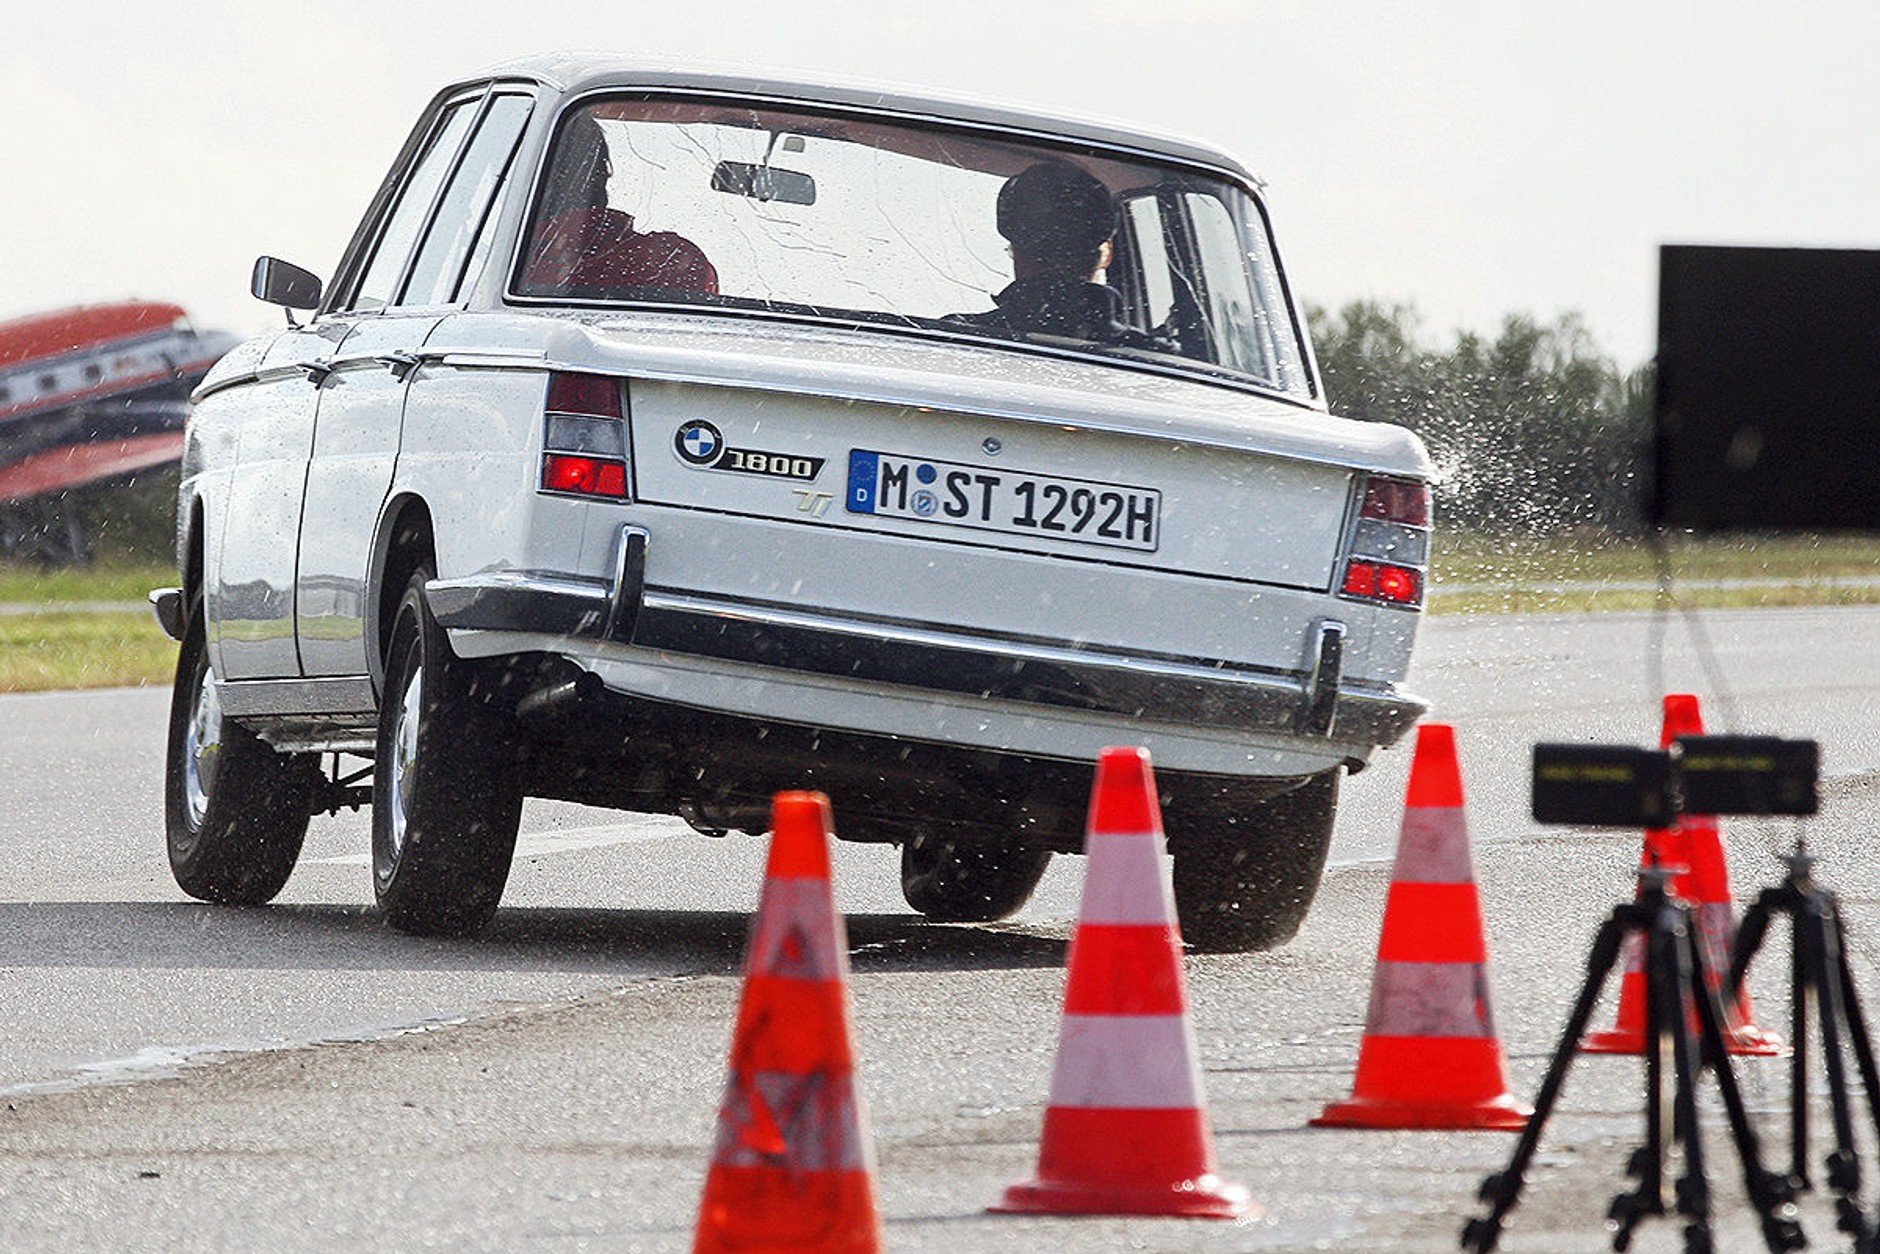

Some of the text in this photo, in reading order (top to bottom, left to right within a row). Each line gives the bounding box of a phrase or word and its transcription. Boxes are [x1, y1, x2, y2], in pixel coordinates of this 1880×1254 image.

[727, 449, 812, 477] 1800
[856, 488, 868, 502] D
[880, 462, 1155, 543] M ST 1292H
